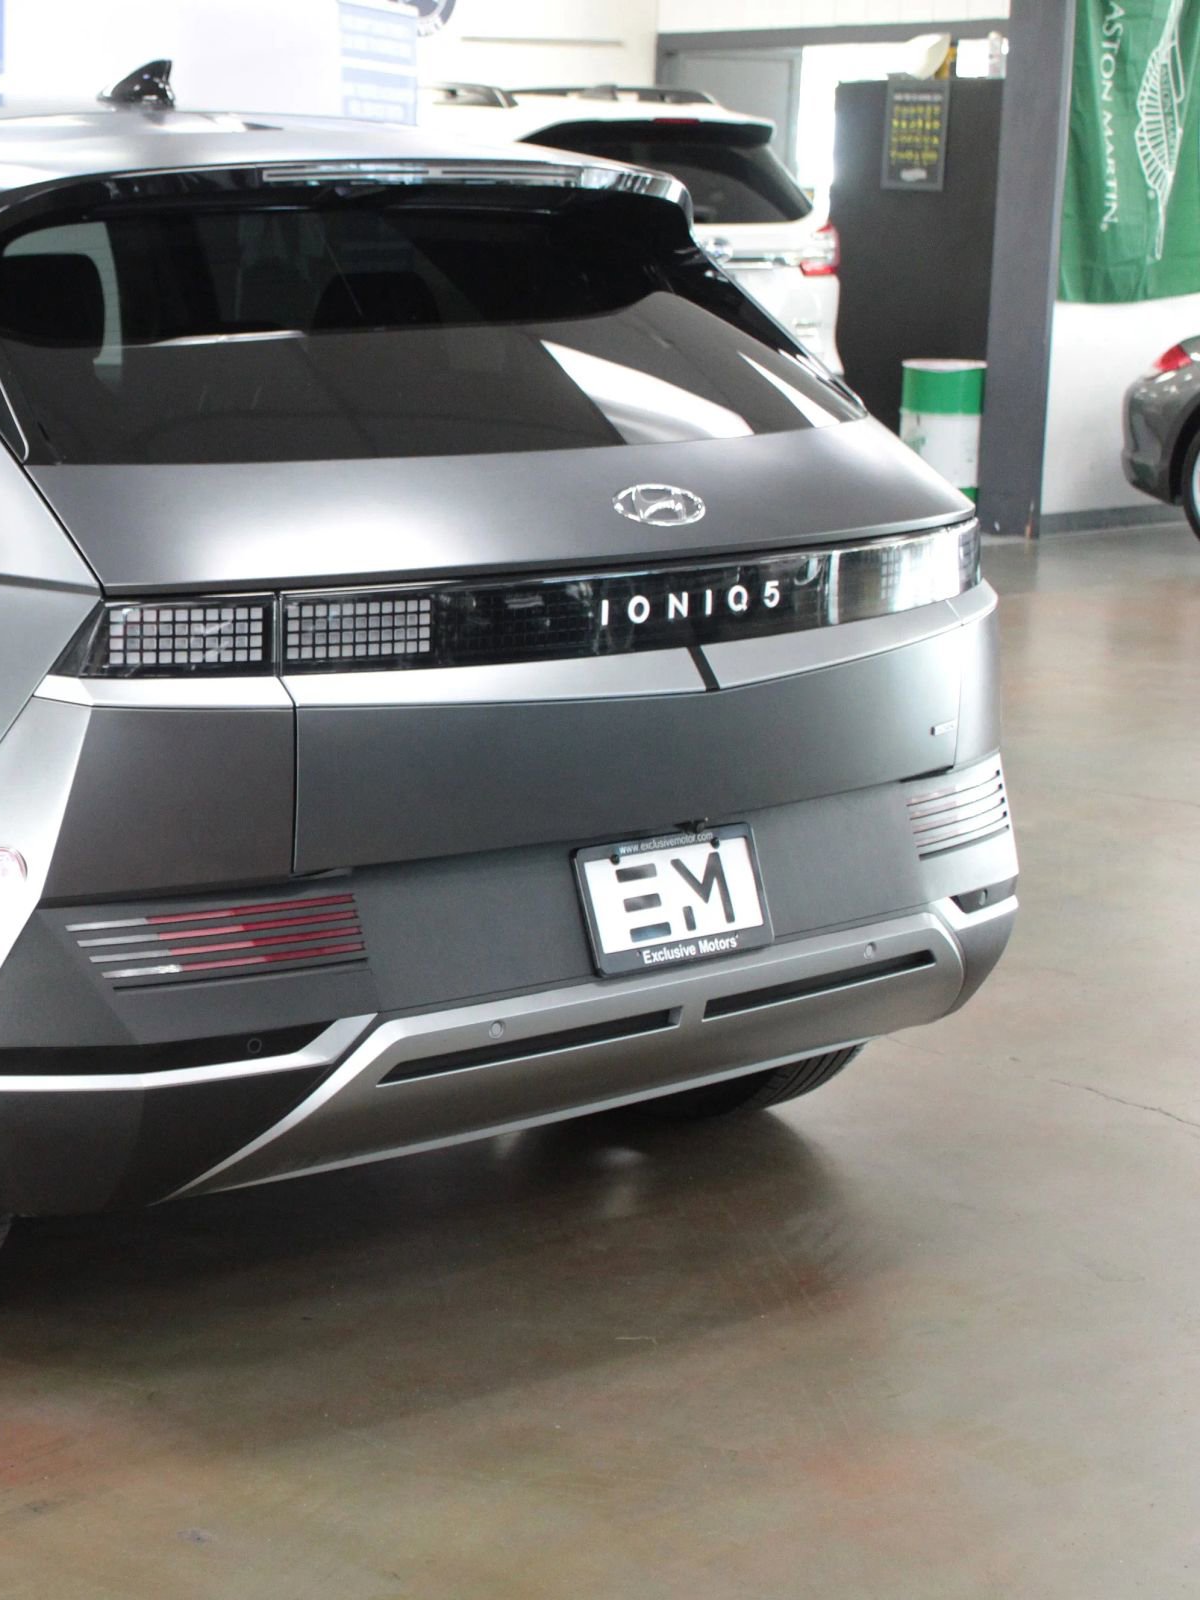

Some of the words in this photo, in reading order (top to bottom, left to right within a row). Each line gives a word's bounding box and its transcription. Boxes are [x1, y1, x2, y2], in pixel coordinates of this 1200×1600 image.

[1102, 1, 1126, 102] ASTON
[1101, 109, 1120, 224] MARTIN
[601, 584, 749, 626] IONIQ
[763, 580, 781, 608] 5
[618, 831, 714, 855] www.exclusivemotor.com
[615, 851, 736, 943] EM
[642, 943, 697, 965] Exclusive
[699, 936, 738, 955] Motors
